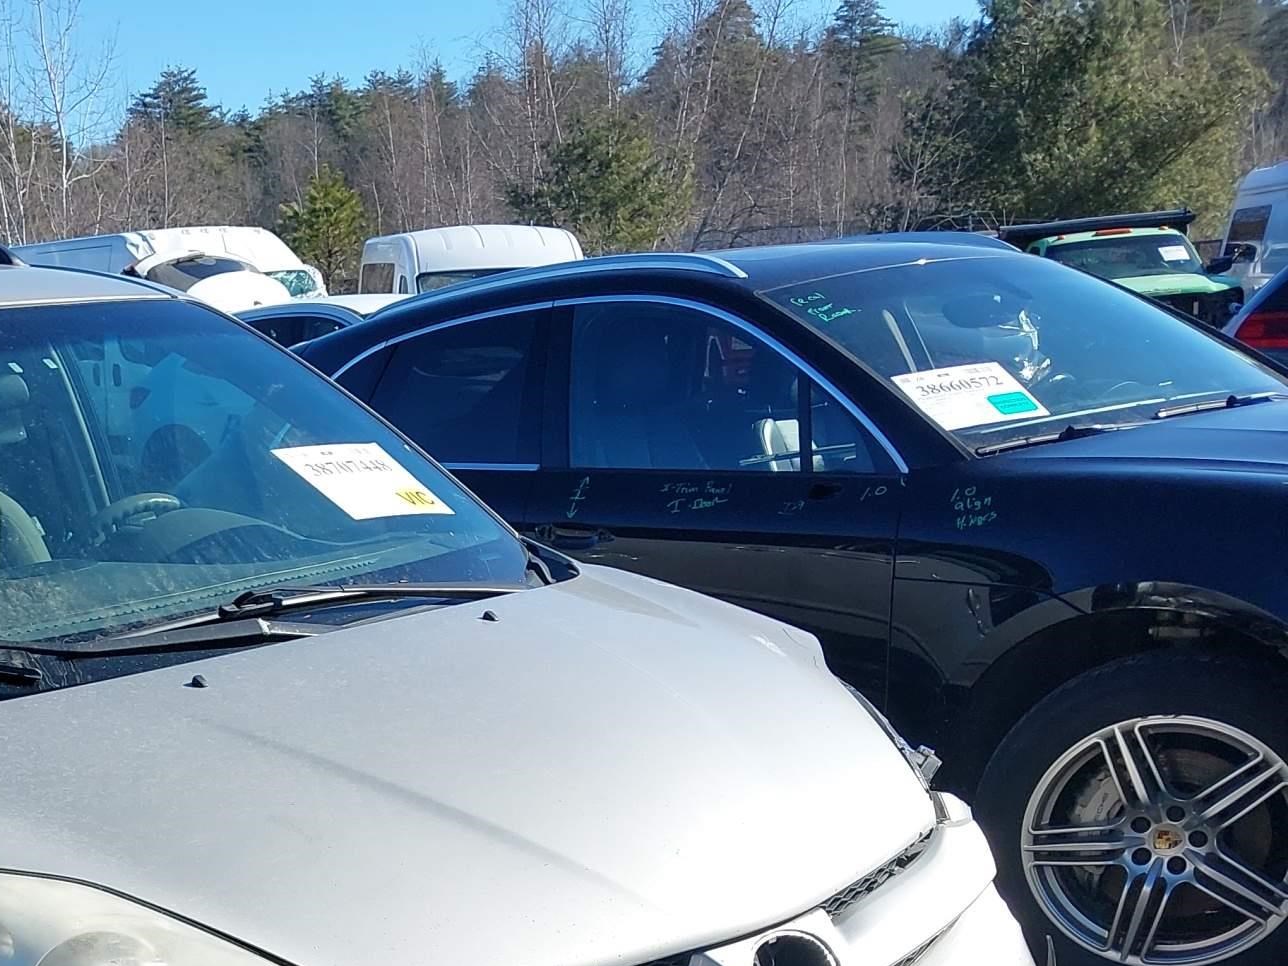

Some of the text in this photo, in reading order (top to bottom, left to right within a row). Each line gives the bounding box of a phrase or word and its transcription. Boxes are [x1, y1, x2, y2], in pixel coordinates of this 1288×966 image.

[915, 375, 1004, 397] 38660572
[303, 461, 393, 477] 38707448
[395, 491, 435, 506] VIC
